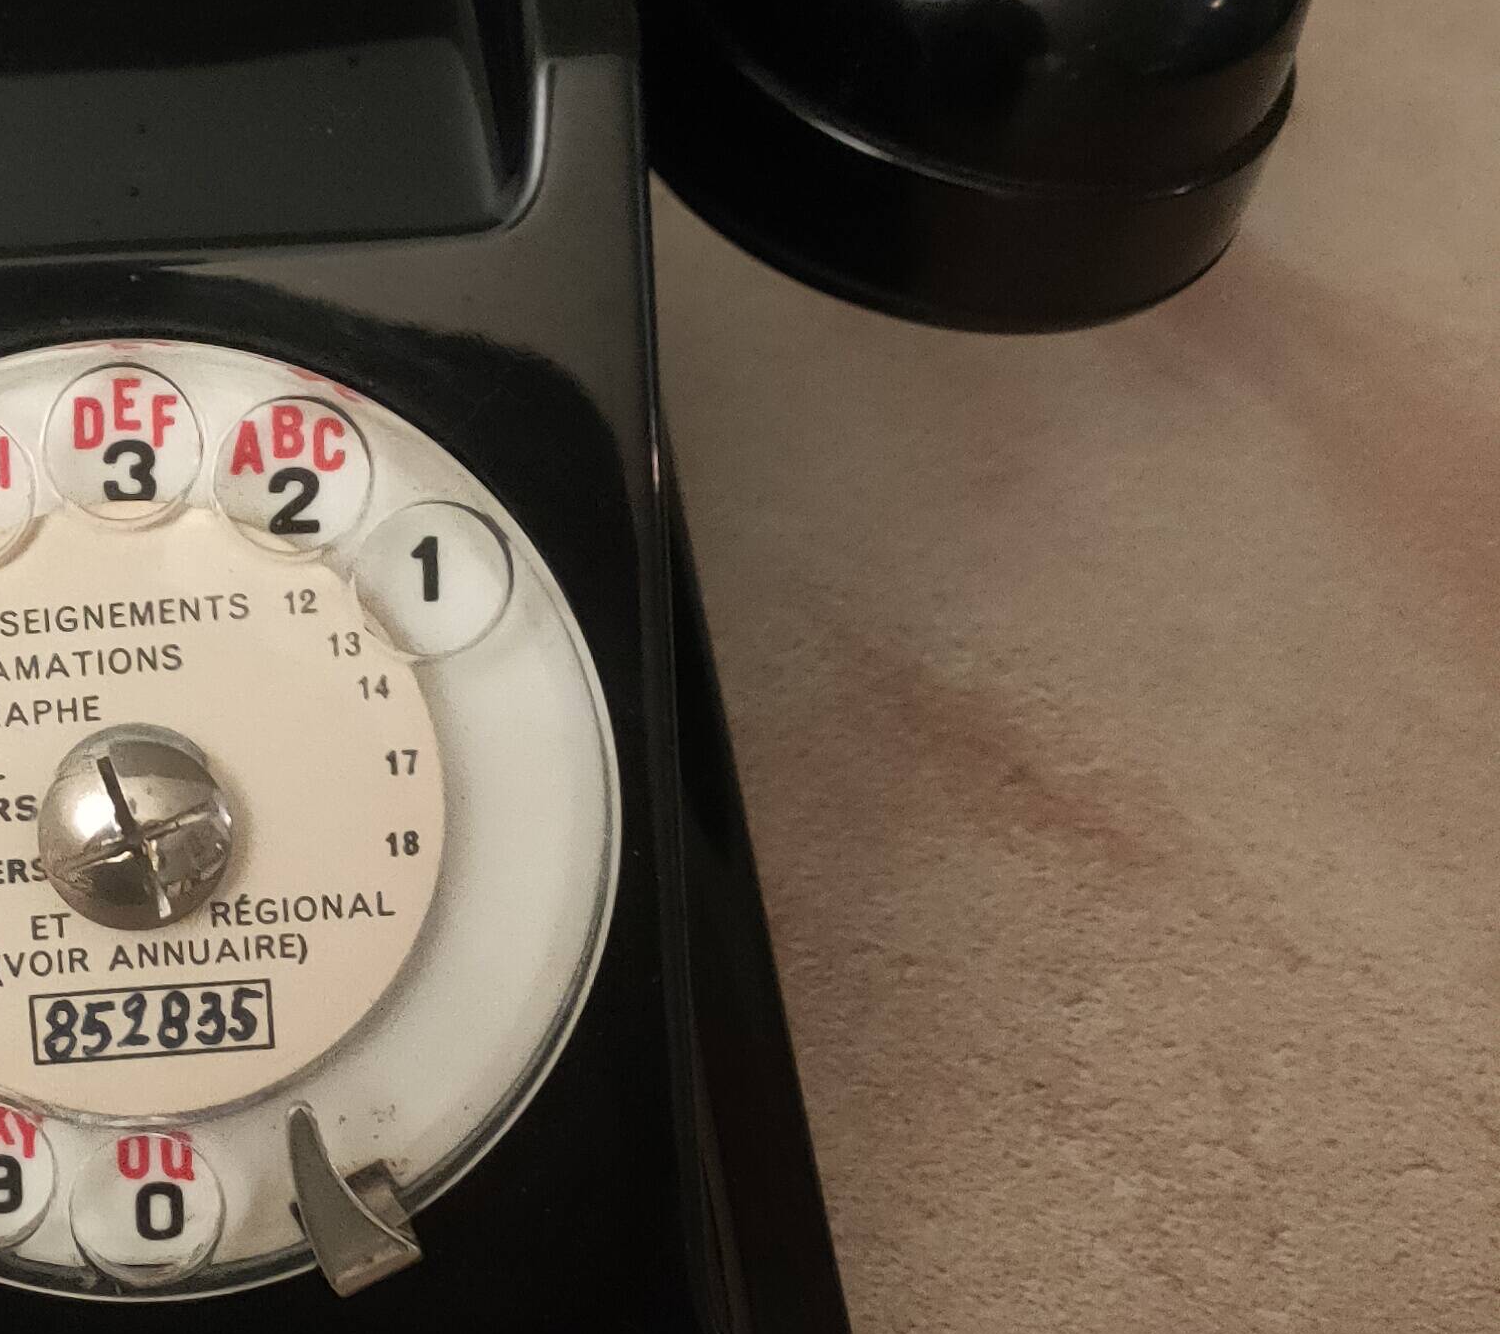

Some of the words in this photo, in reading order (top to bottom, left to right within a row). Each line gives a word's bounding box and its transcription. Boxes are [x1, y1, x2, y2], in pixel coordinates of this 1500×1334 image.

[73, 378, 177, 450] DEF
[230, 405, 346, 475] ABC
[102, 440, 157, 501] 3
[268, 467, 320, 535] 2
[411, 536, 440, 602] 1
[284, 589, 318, 615] 12
[329, 632, 362, 657] 13
[358, 674, 390, 700] 14
[386, 750, 418, 776] 17
[386, 831, 420, 856] 18
[31, 913, 71, 940] ET
[211, 891, 396, 927] RÉGIONAL
[109, 933, 308, 971] ANNUAIRE)
[44, 987, 263, 1060] 852835
[136, 1182, 184, 1240] 0
